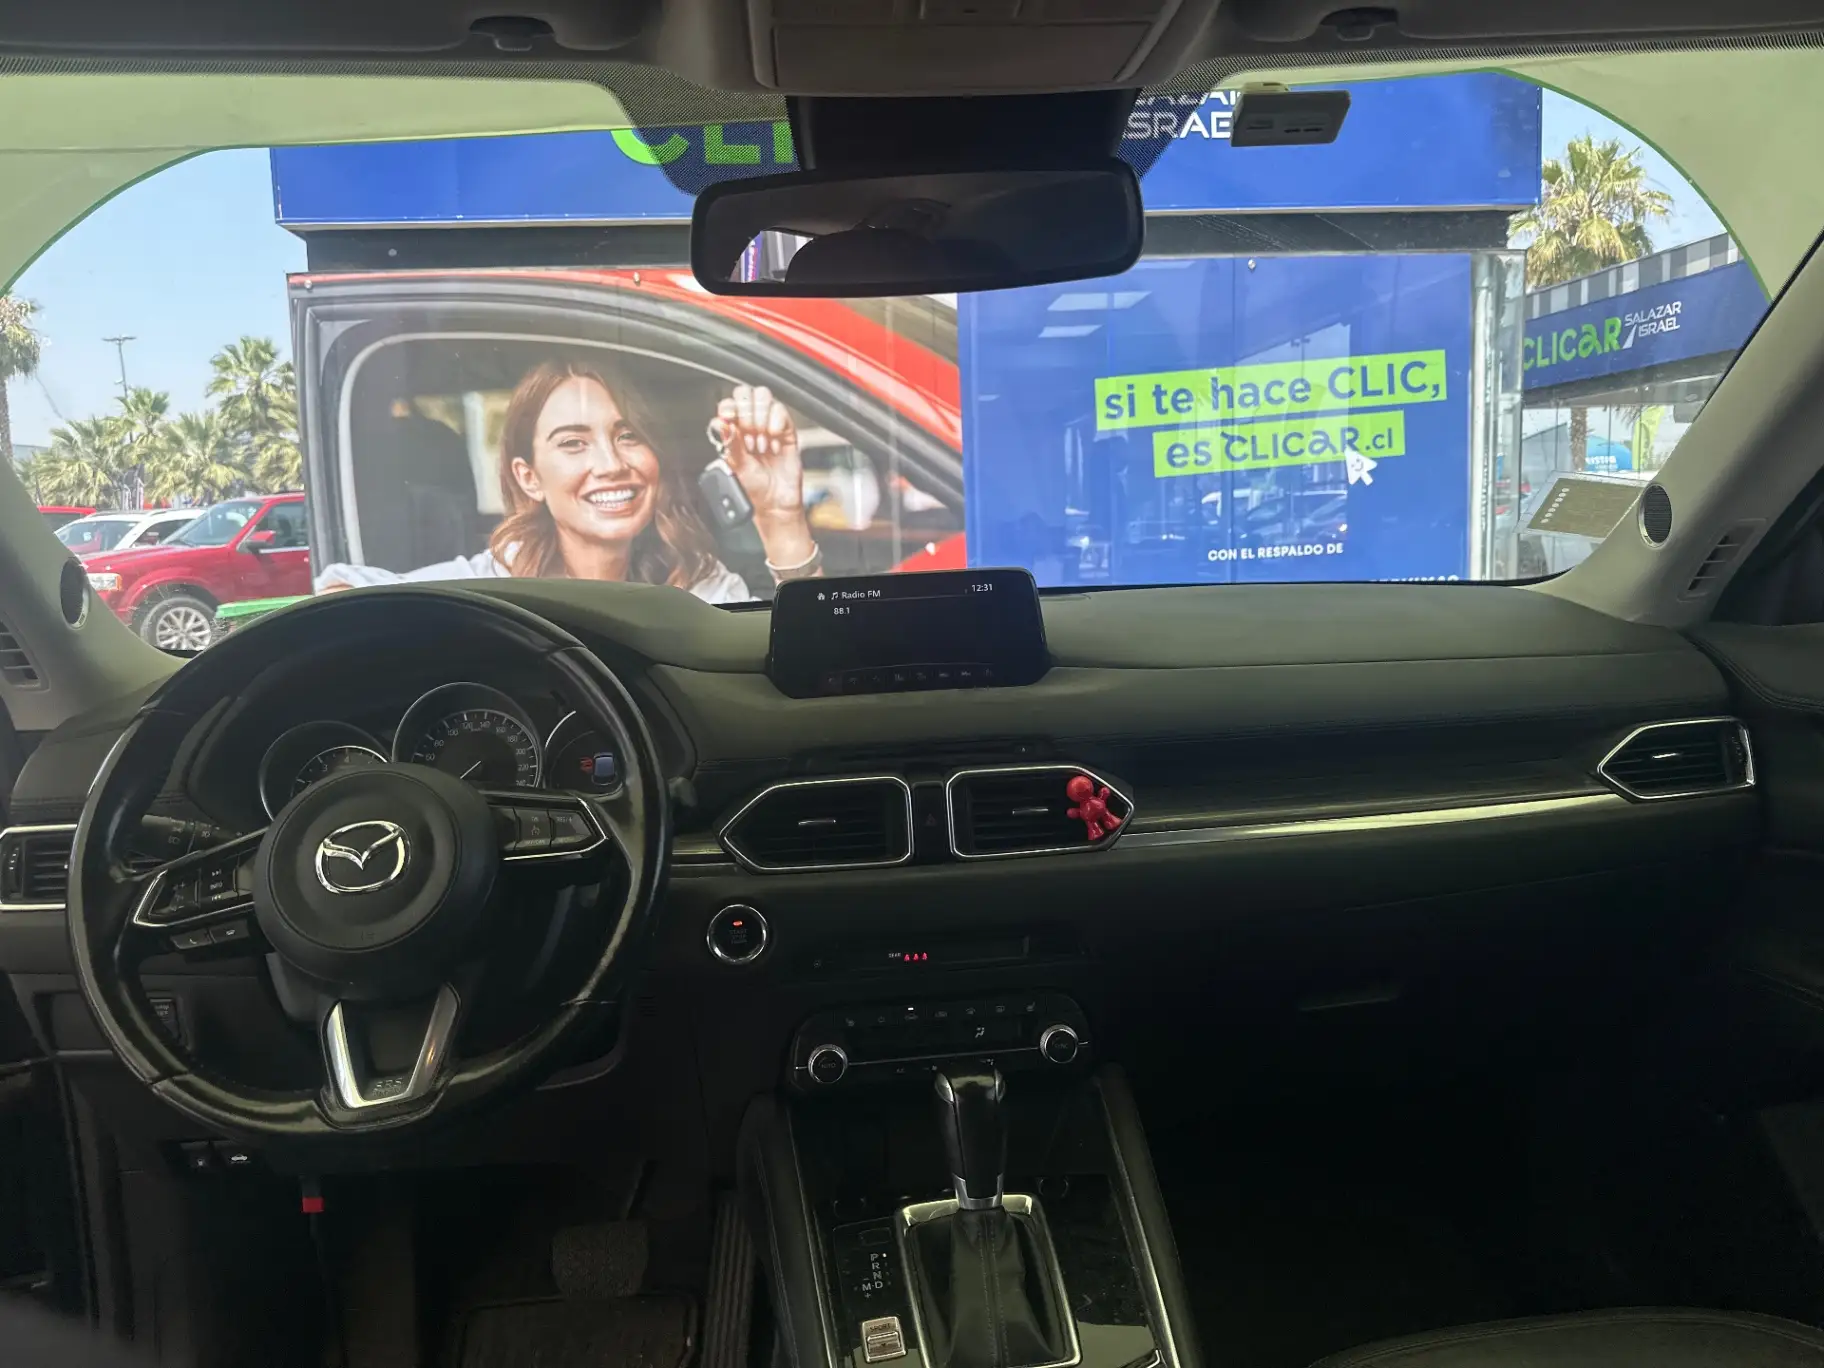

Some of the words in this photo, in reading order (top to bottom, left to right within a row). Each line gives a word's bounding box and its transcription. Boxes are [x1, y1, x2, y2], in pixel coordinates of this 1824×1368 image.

[1624, 301, 1682, 327] SALAZAR
[1638, 317, 1681, 338] ISRAEL
[1104, 384, 1136, 420] si
[1152, 384, 1195, 415] te
[1210, 377, 1312, 411] hace
[1328, 361, 1441, 399] CLIC,
[1166, 441, 1212, 469] es
[1207, 548, 1238, 561] CON
[1240, 547, 1256, 560] EL
[1257, 543, 1324, 559] RESPALDO
[1326, 542, 1345, 555] DE
[841, 590, 866, 600] Radio
[867, 589, 881, 599] FM
[971, 583, 993, 592] 12:31
[833, 606, 851, 616] 88.1
[870, 1253, 879, 1261] P
[871, 1262, 880, 1270] R
[873, 1270, 883, 1280] N
[862, 1282, 872, 1291] M
[874, 1280, 884, 1289] D
